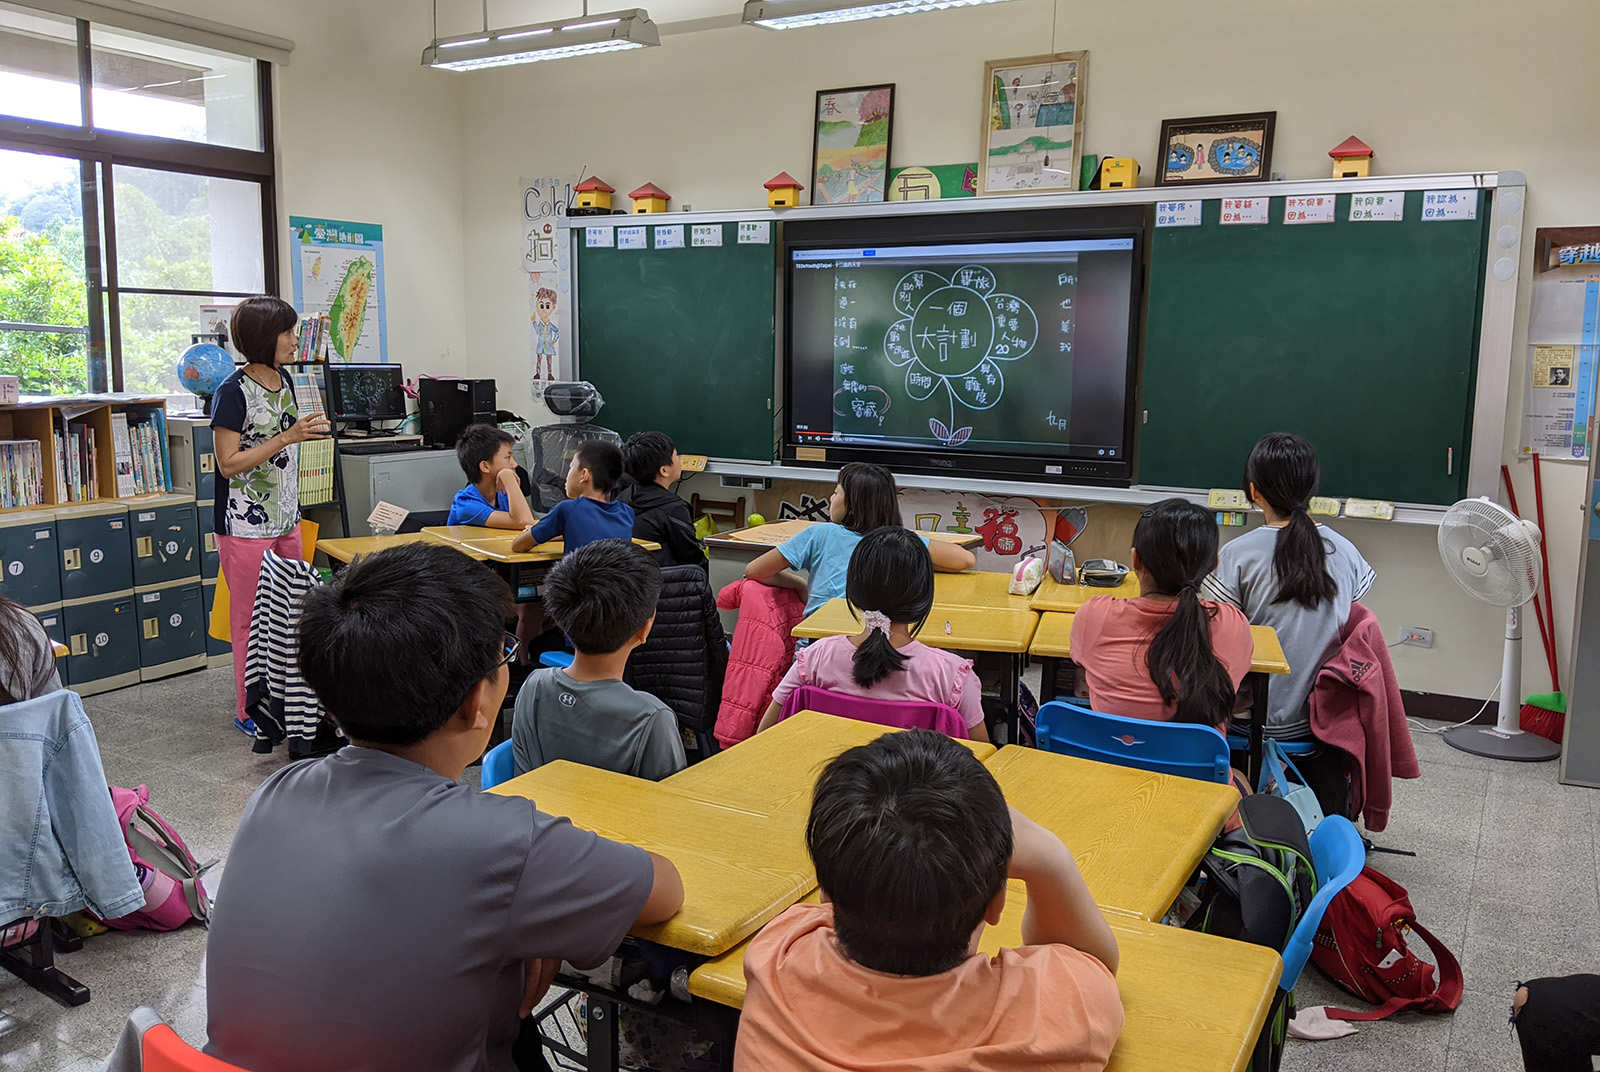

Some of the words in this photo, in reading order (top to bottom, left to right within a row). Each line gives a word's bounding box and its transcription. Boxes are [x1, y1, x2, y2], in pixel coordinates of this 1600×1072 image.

[821, 96, 842, 116] 春
[929, 301, 968, 317] 一個
[916, 324, 977, 362] 大計劃
[995, 343, 1010, 355] 20
[909, 372, 932, 389] 時間
[1045, 410, 1067, 431] 九月
[168, 542, 177, 553] 11
[93, 551, 100, 562] 9
[12, 563, 20, 574] 7
[170, 615, 181, 625] 12
[96, 634, 107, 645] 10
[1354, 661, 1374, 683] adidas
